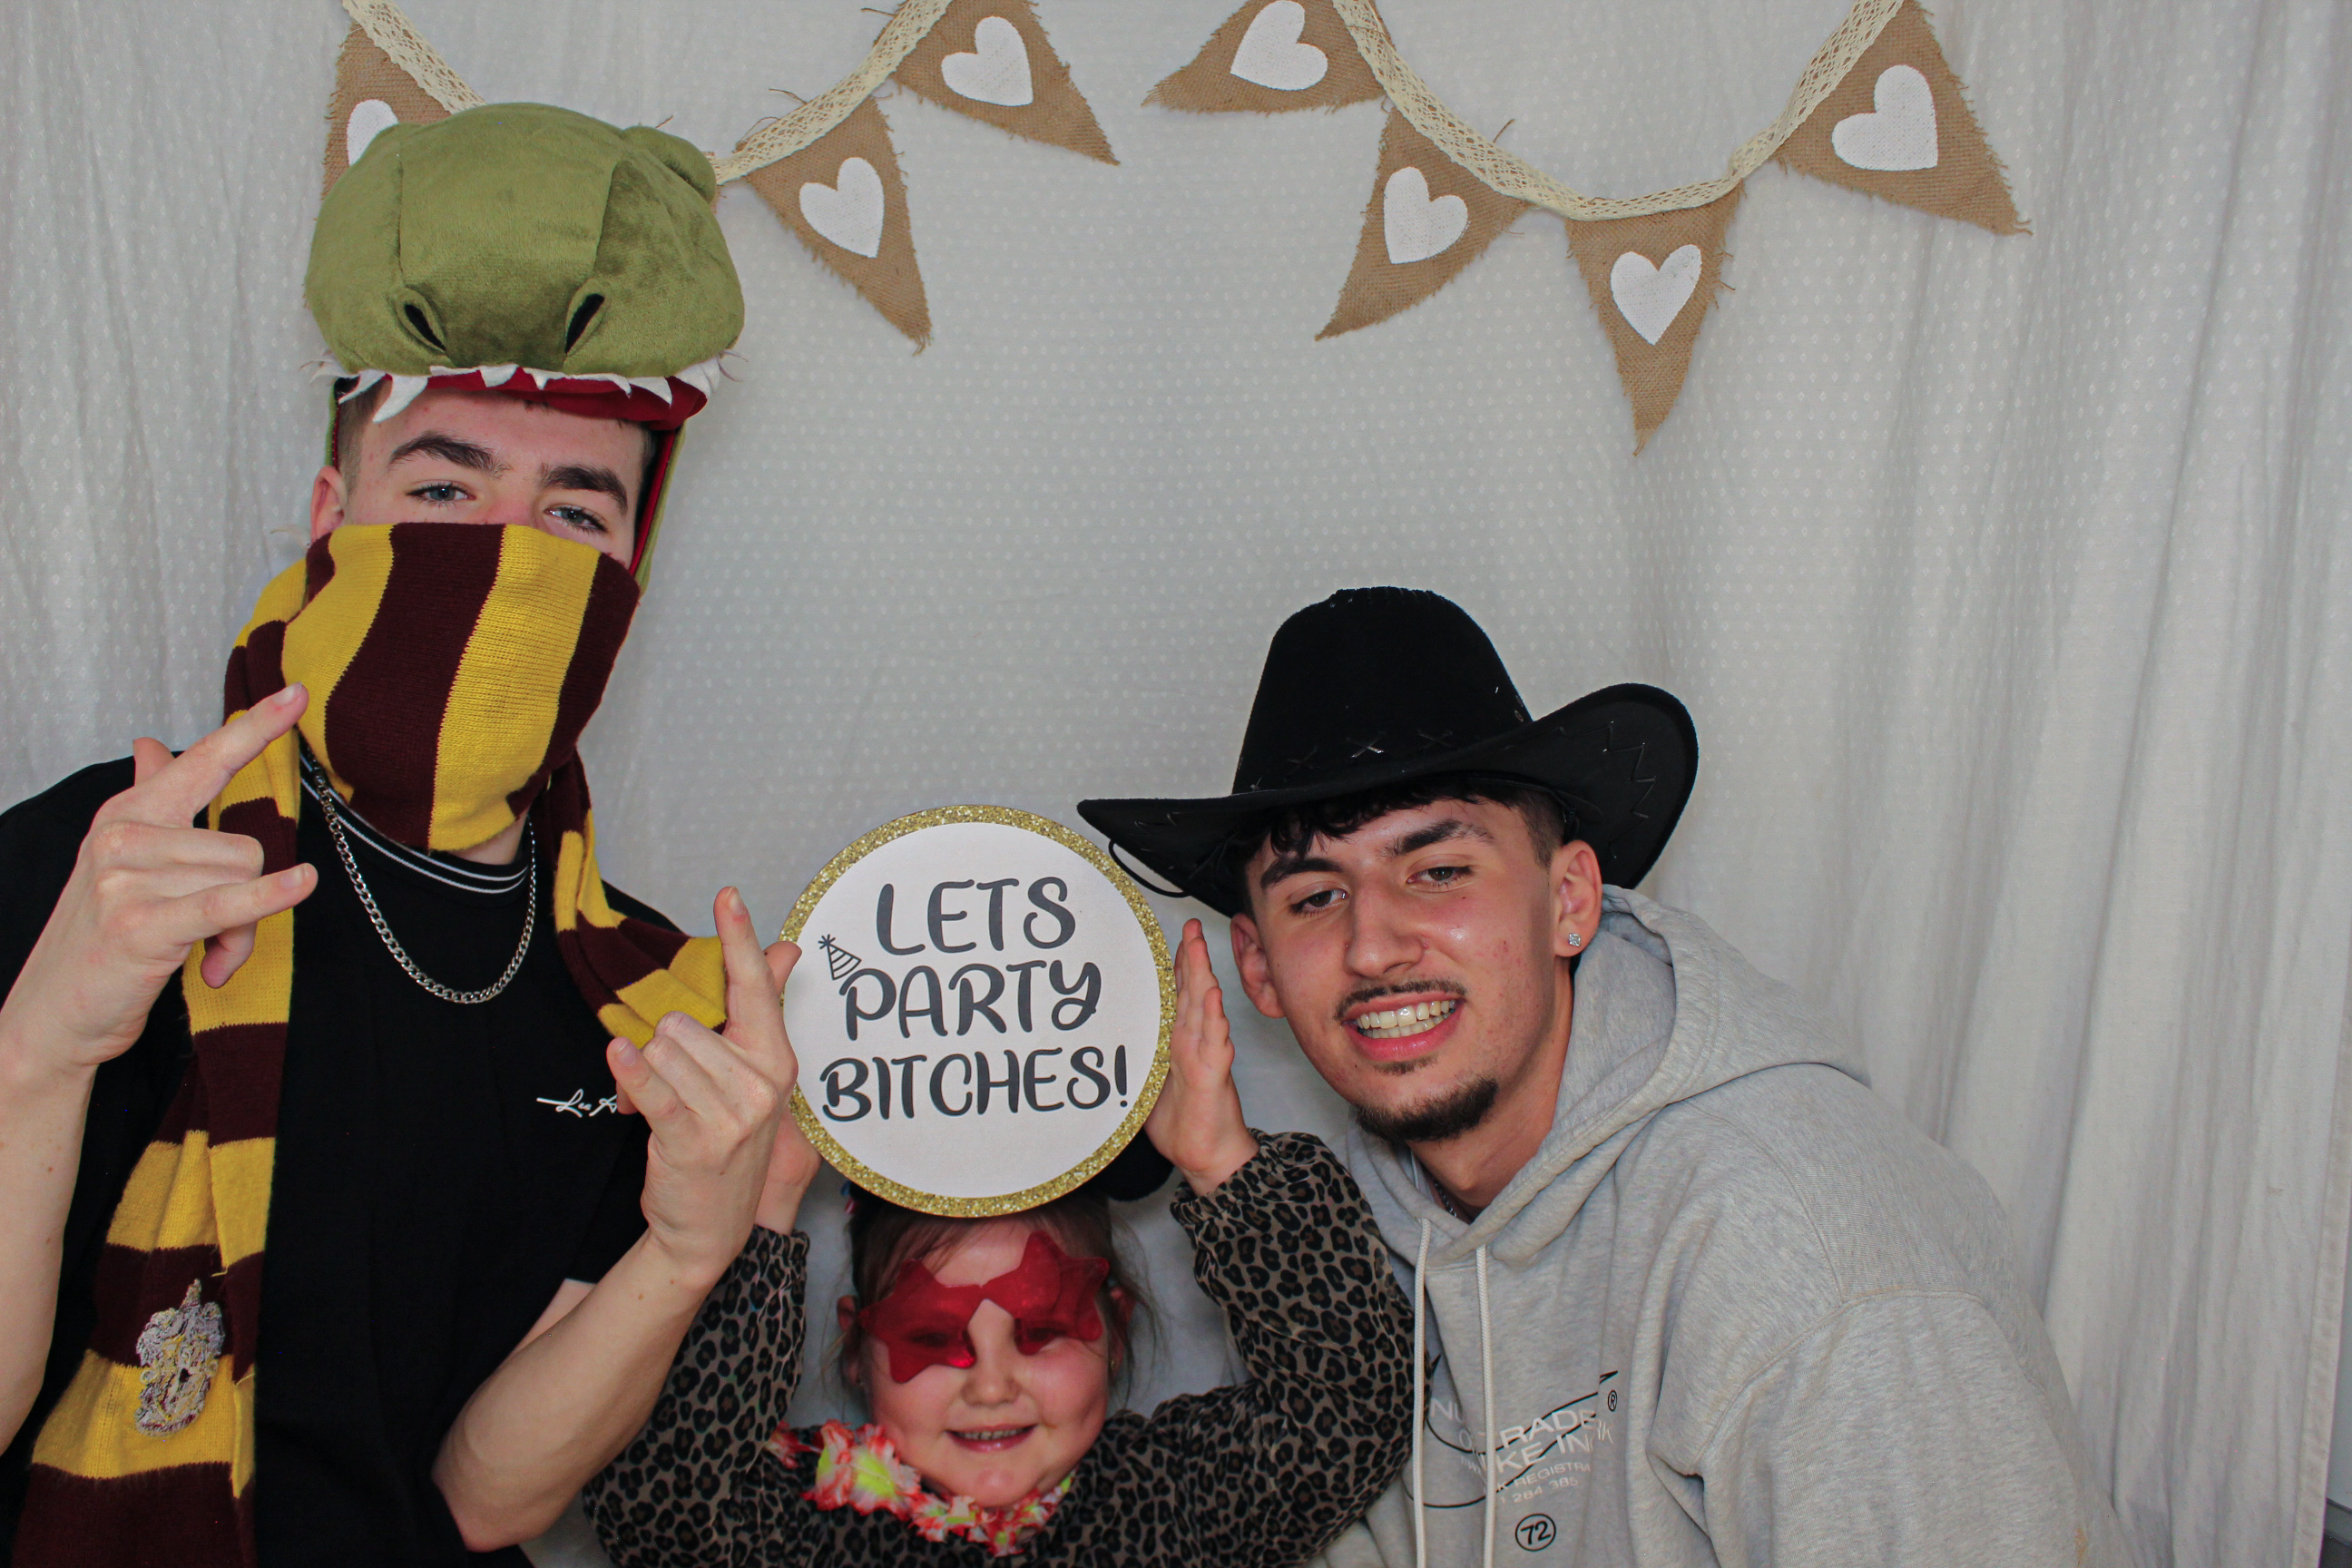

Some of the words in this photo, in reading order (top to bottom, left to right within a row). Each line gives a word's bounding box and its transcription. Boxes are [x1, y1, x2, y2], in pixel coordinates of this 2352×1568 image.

[876, 876, 1077, 956] LETS
[838, 959, 1102, 1042] PARTY
[819, 1044, 1129, 1122] BITCHES!
[1555, 1434, 1594, 1455] IN
[1513, 1461, 1592, 1489] REGISTRA
[1514, 1485, 1544, 1504] 284
[1520, 1520, 1552, 1546] 72
